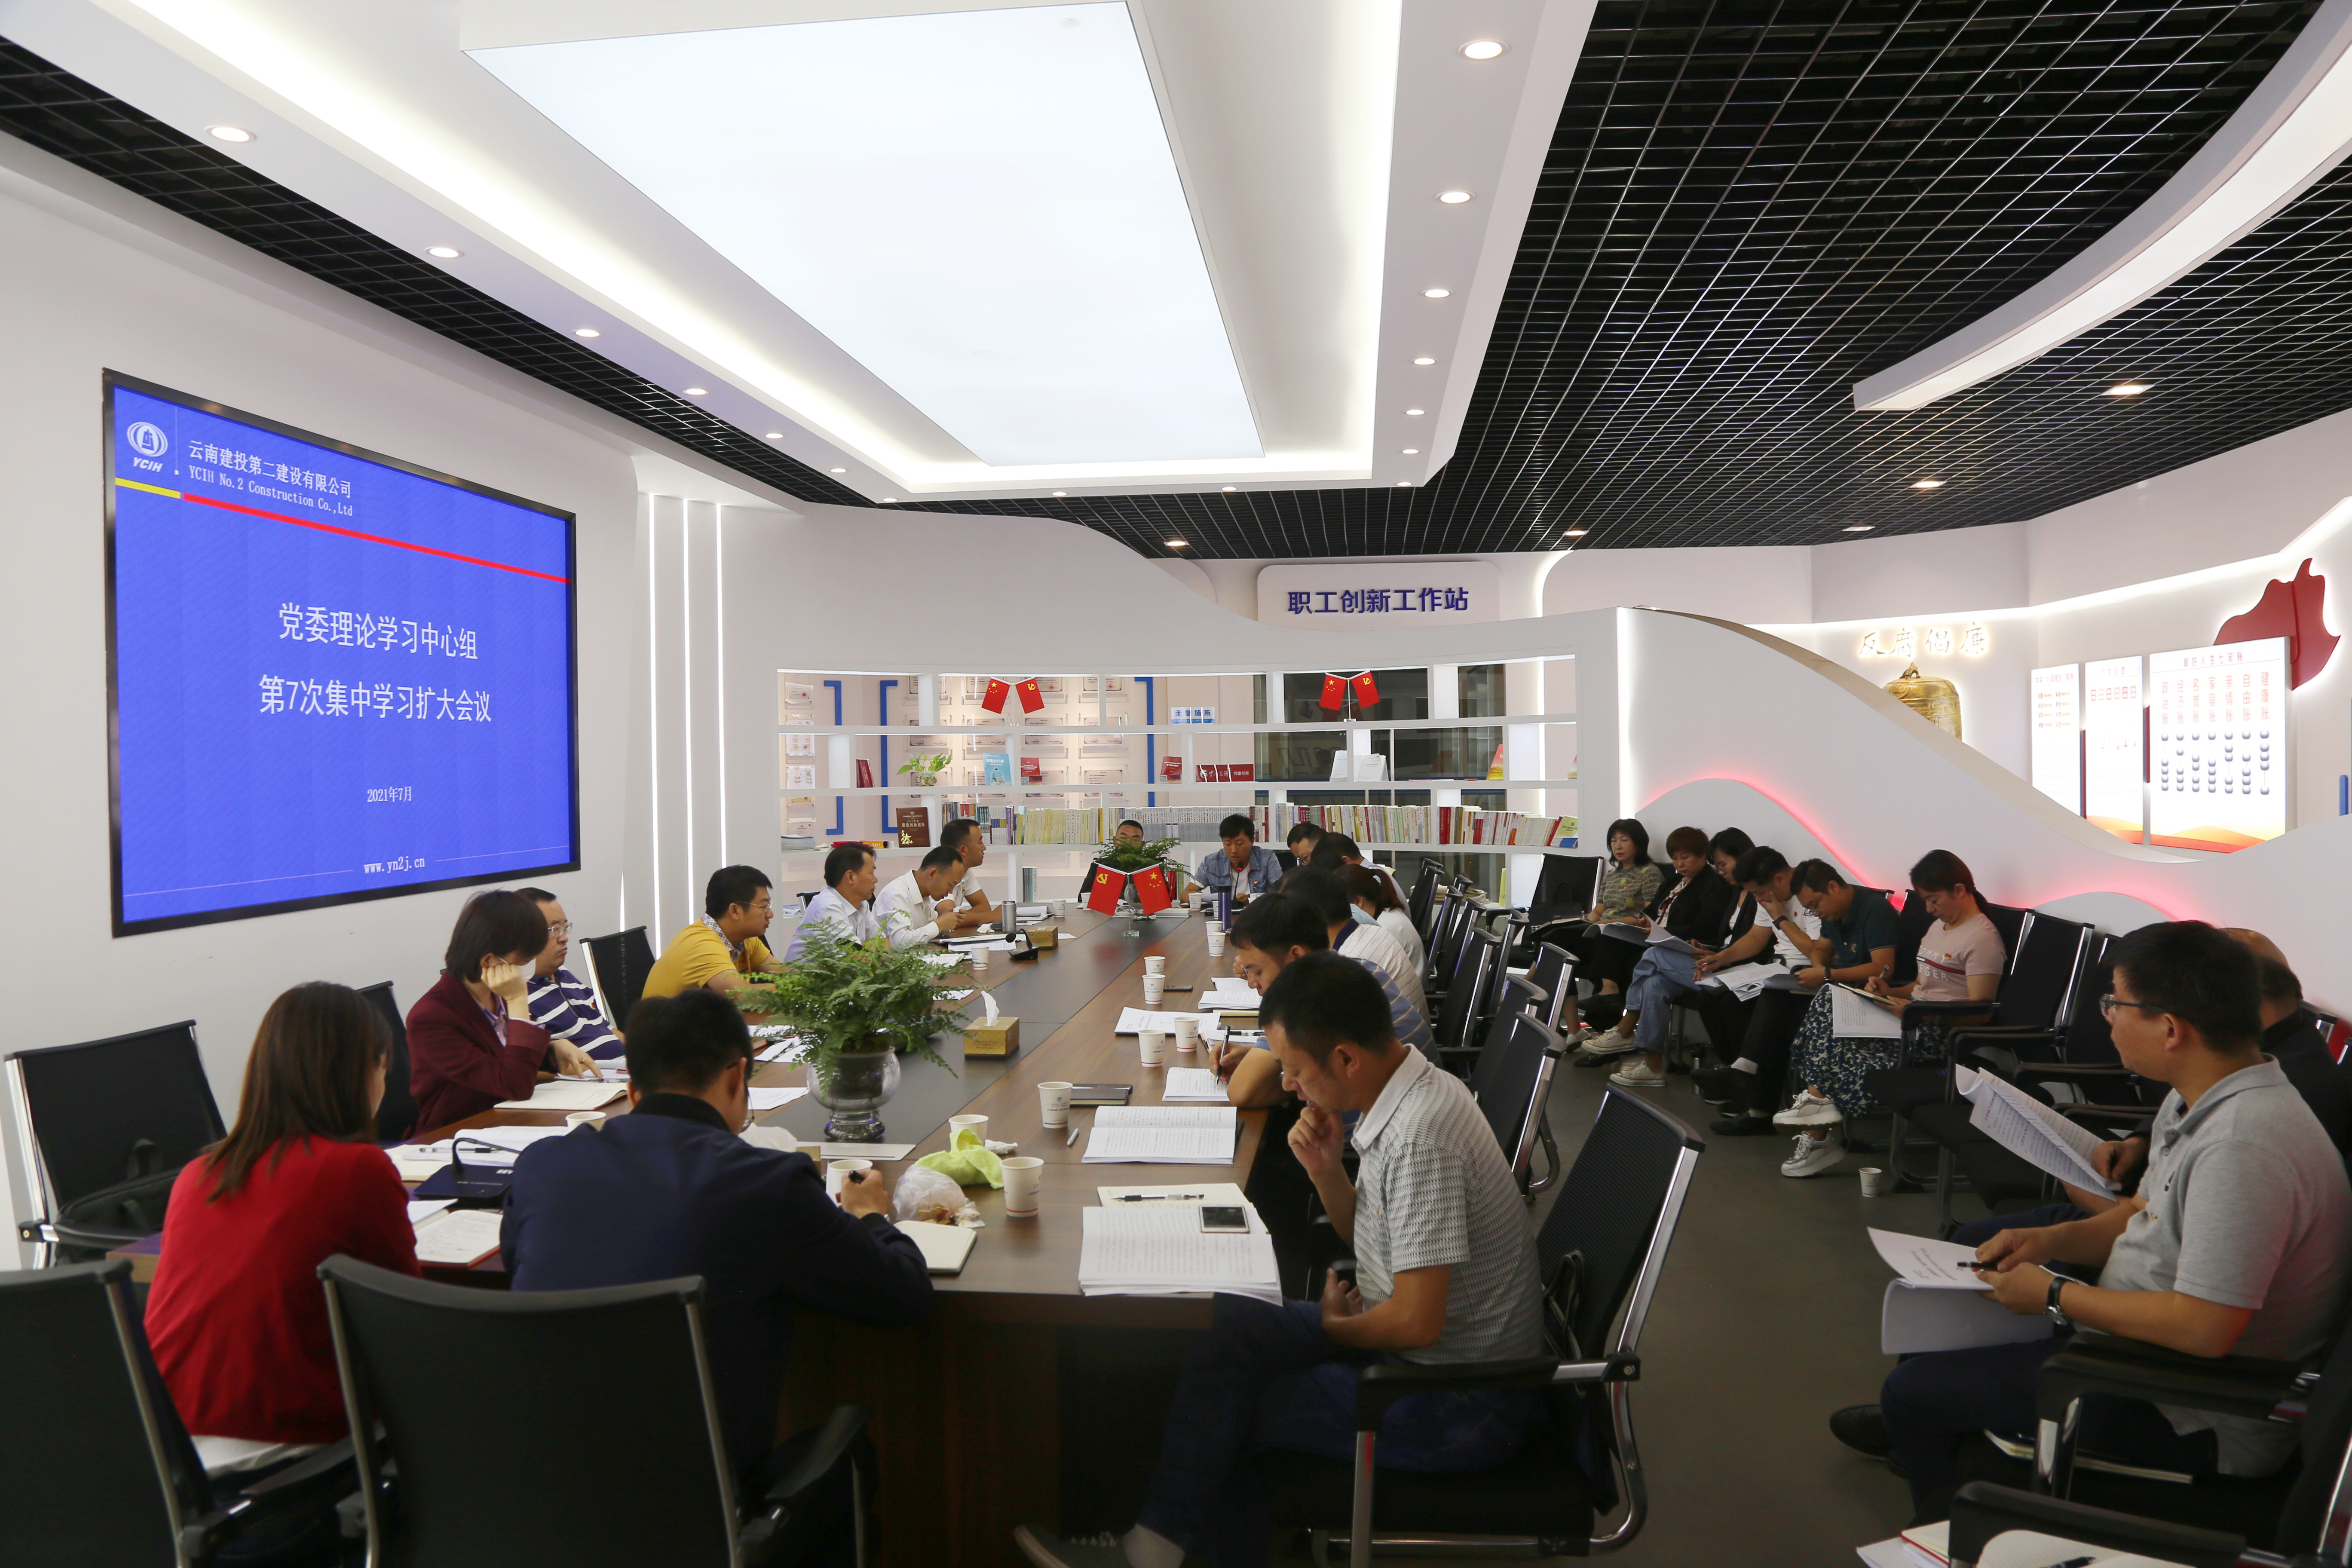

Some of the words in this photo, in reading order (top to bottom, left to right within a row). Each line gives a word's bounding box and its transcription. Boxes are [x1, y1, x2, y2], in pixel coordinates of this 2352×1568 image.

[133, 457, 163, 472] YCIH
[189, 440, 350, 499] 云南建投第二建设有限公司
[189, 465, 214, 483] YCIH
[249, 480, 314, 507] Construction
[318, 497, 352, 516] Co.,Ltd
[1288, 587, 1469, 615] 职工创新工作站
[279, 602, 478, 659] 党委理论学习中心组
[1858, 621, 1987, 657] 反腐倡廉
[259, 674, 492, 722] 第7次集中学习扩大会议
[367, 786, 411, 802] 2021年7月
[364, 856, 425, 874] www.yn2j.cn
